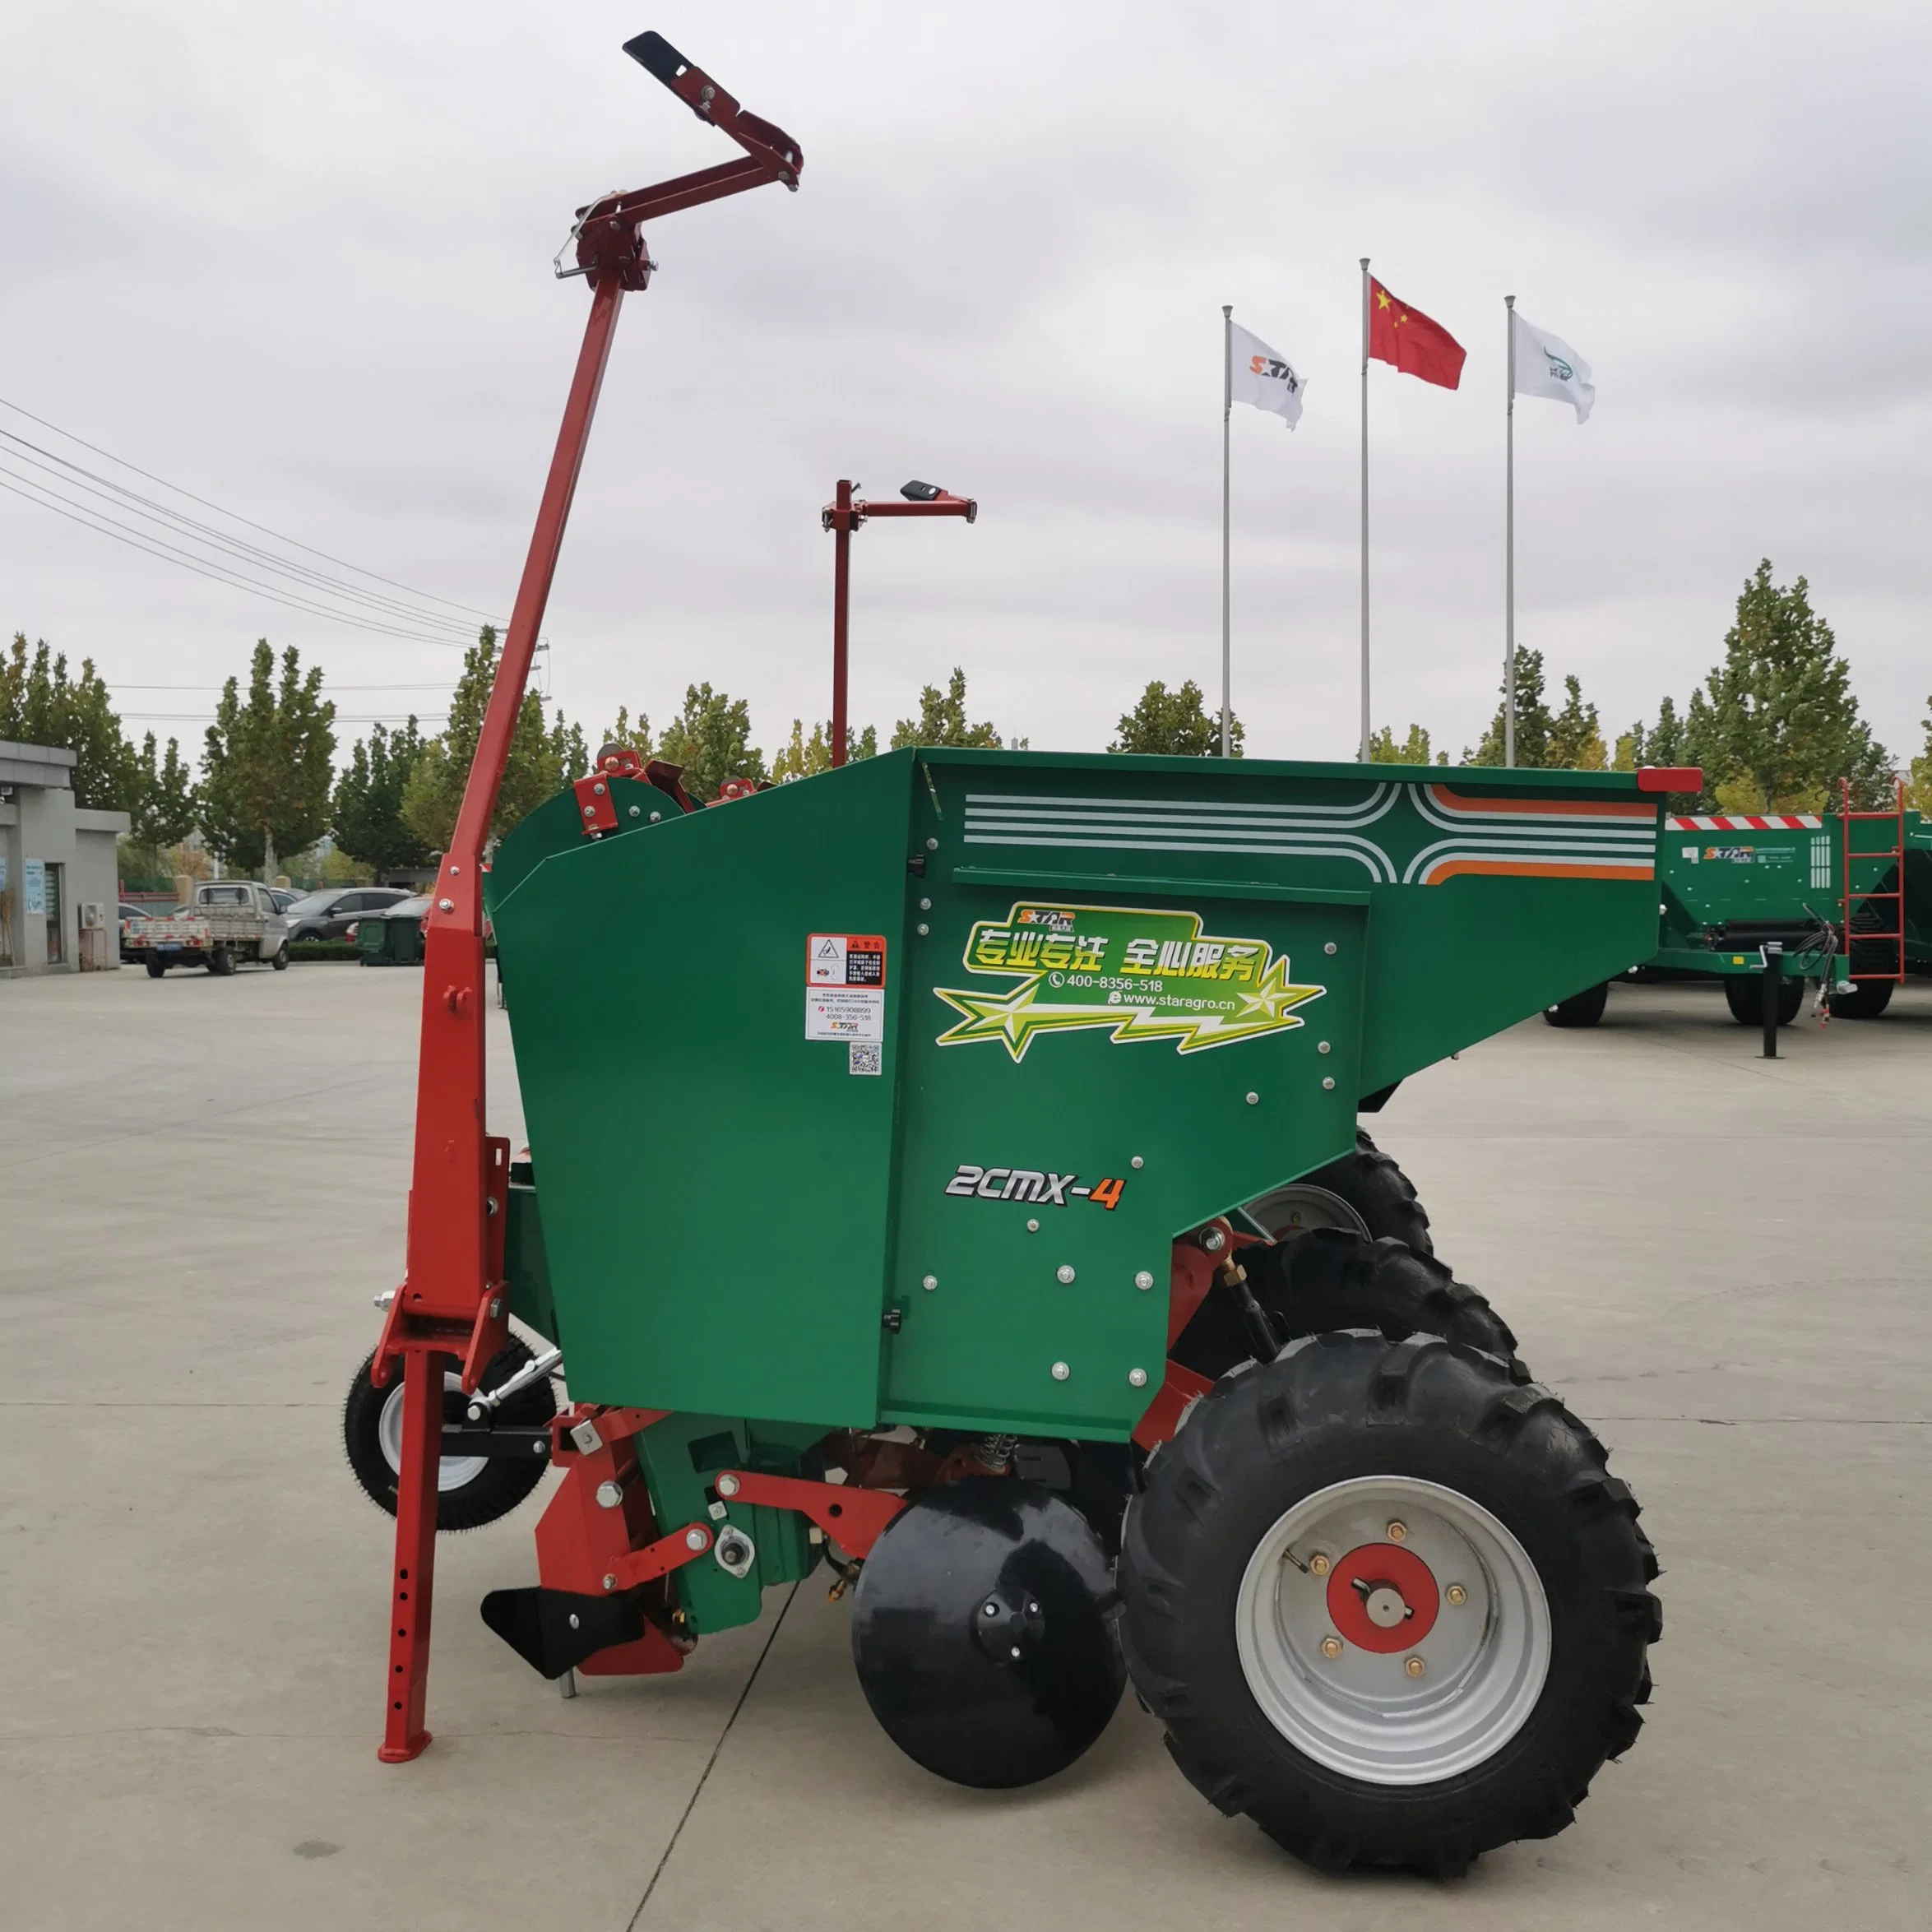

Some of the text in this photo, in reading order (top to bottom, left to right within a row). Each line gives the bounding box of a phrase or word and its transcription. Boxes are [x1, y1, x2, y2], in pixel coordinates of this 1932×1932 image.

[1017, 910, 1076, 925] STAR
[975, 929, 1259, 981] 专业专注 全心服务
[1067, 975, 1163, 992] 400-8356-518
[1124, 994, 1235, 1011] www.staragro.cn
[945, 1165, 1126, 1211] 2CMX-4
